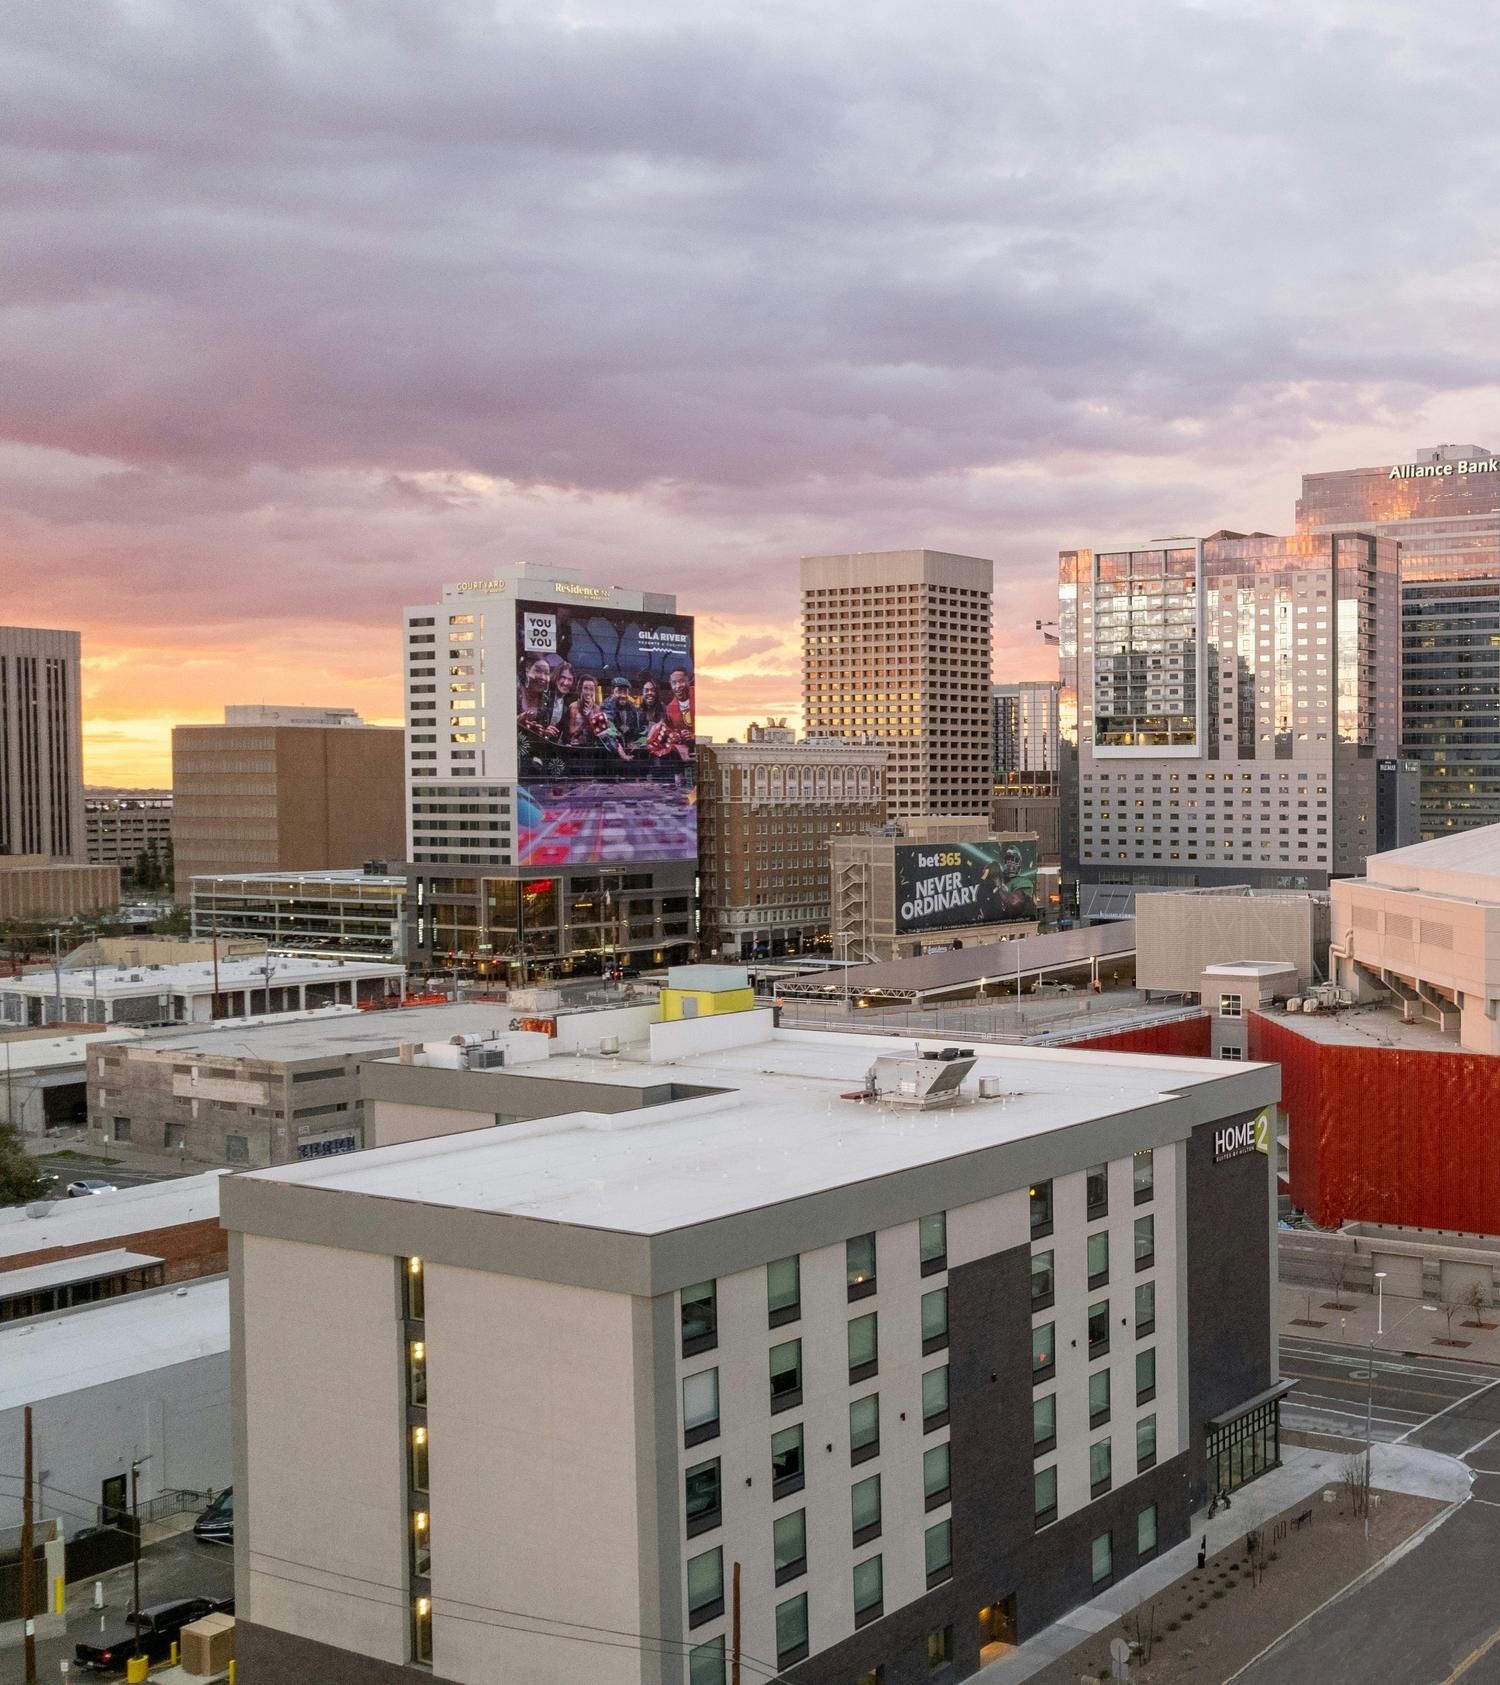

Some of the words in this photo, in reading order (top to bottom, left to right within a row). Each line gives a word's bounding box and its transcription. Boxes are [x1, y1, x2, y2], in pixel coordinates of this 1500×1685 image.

[1388, 463, 1453, 480] Alliance
[1457, 459, 1498, 474] Bank
[456, 579, 506, 592] COURTYARD
[555, 582, 600, 596] Residence
[529, 617, 552, 628] YOU
[532, 628, 548, 637] DO
[638, 631, 660, 640] GILA
[660, 632, 688, 643] RIVER
[529, 637, 552, 648] YOU
[918, 852, 962, 868] bet365
[915, 871, 963, 900] NEVER
[900, 884, 980, 921] ORDINARY
